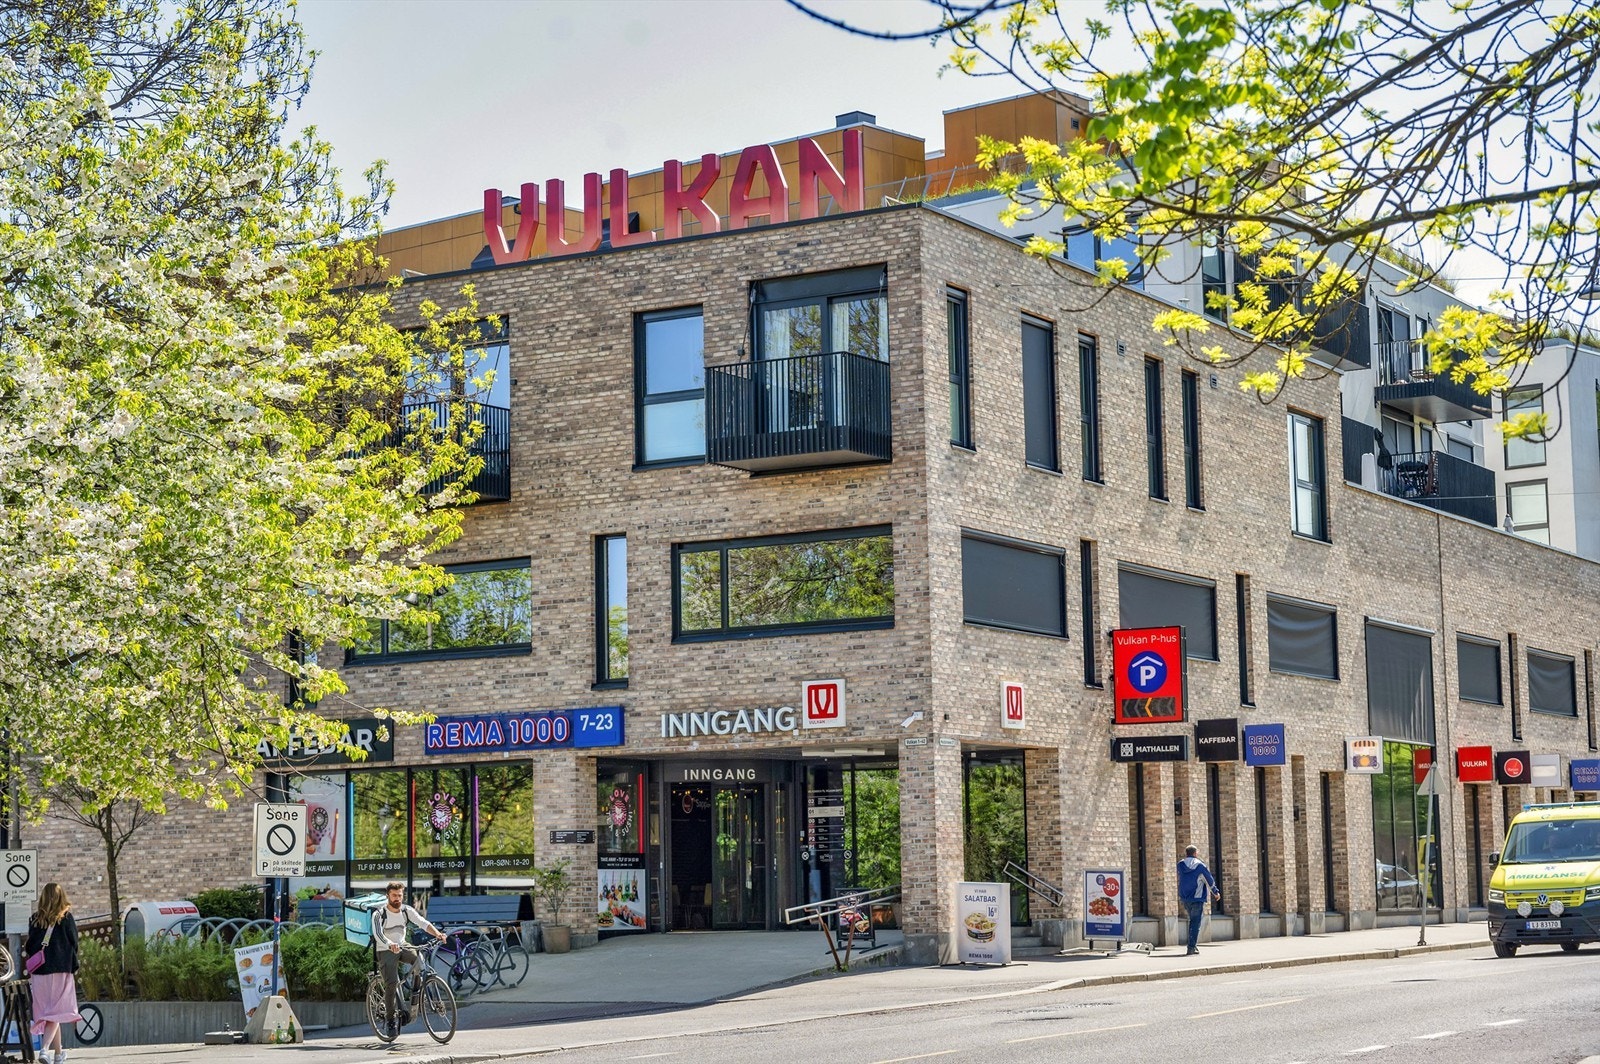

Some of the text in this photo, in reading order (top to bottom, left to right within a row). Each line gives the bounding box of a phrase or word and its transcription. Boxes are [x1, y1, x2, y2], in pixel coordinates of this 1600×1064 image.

[483, 129, 864, 265] VULKAN
[1117, 634, 1177, 646] Vulkan P-hus
[1140, 665, 1157, 687] P
[580, 713, 614, 732] 7-23
[661, 706, 797, 738] INNGANG
[427, 716, 570, 749] REMA 1000
[237, 729, 374, 759] AFEAR
[1199, 736, 1236, 745] KAFFEBAR
[1248, 735, 1280, 745] REMA
[1135, 745, 1180, 753] MATHALLEN
[1252, 746, 1277, 756] 1000
[1461, 760, 1488, 768] VULKAN
[684, 768, 756, 781] INNGANG
[427, 792, 456, 806] LOVE
[609, 789, 630, 803] LOVE
[266, 807, 299, 821] Sone
[422, 815, 433, 836] TEA
[444, 813, 461, 840] SUSHI
[621, 811, 633, 837] SUSHI
[5, 852, 31, 863] Sone
[513, 858, 530, 866] 12-20
[262, 861, 269, 871] P
[1507, 871, 1588, 880] AMBULANSE
[964, 894, 997, 903] SALATBAR
